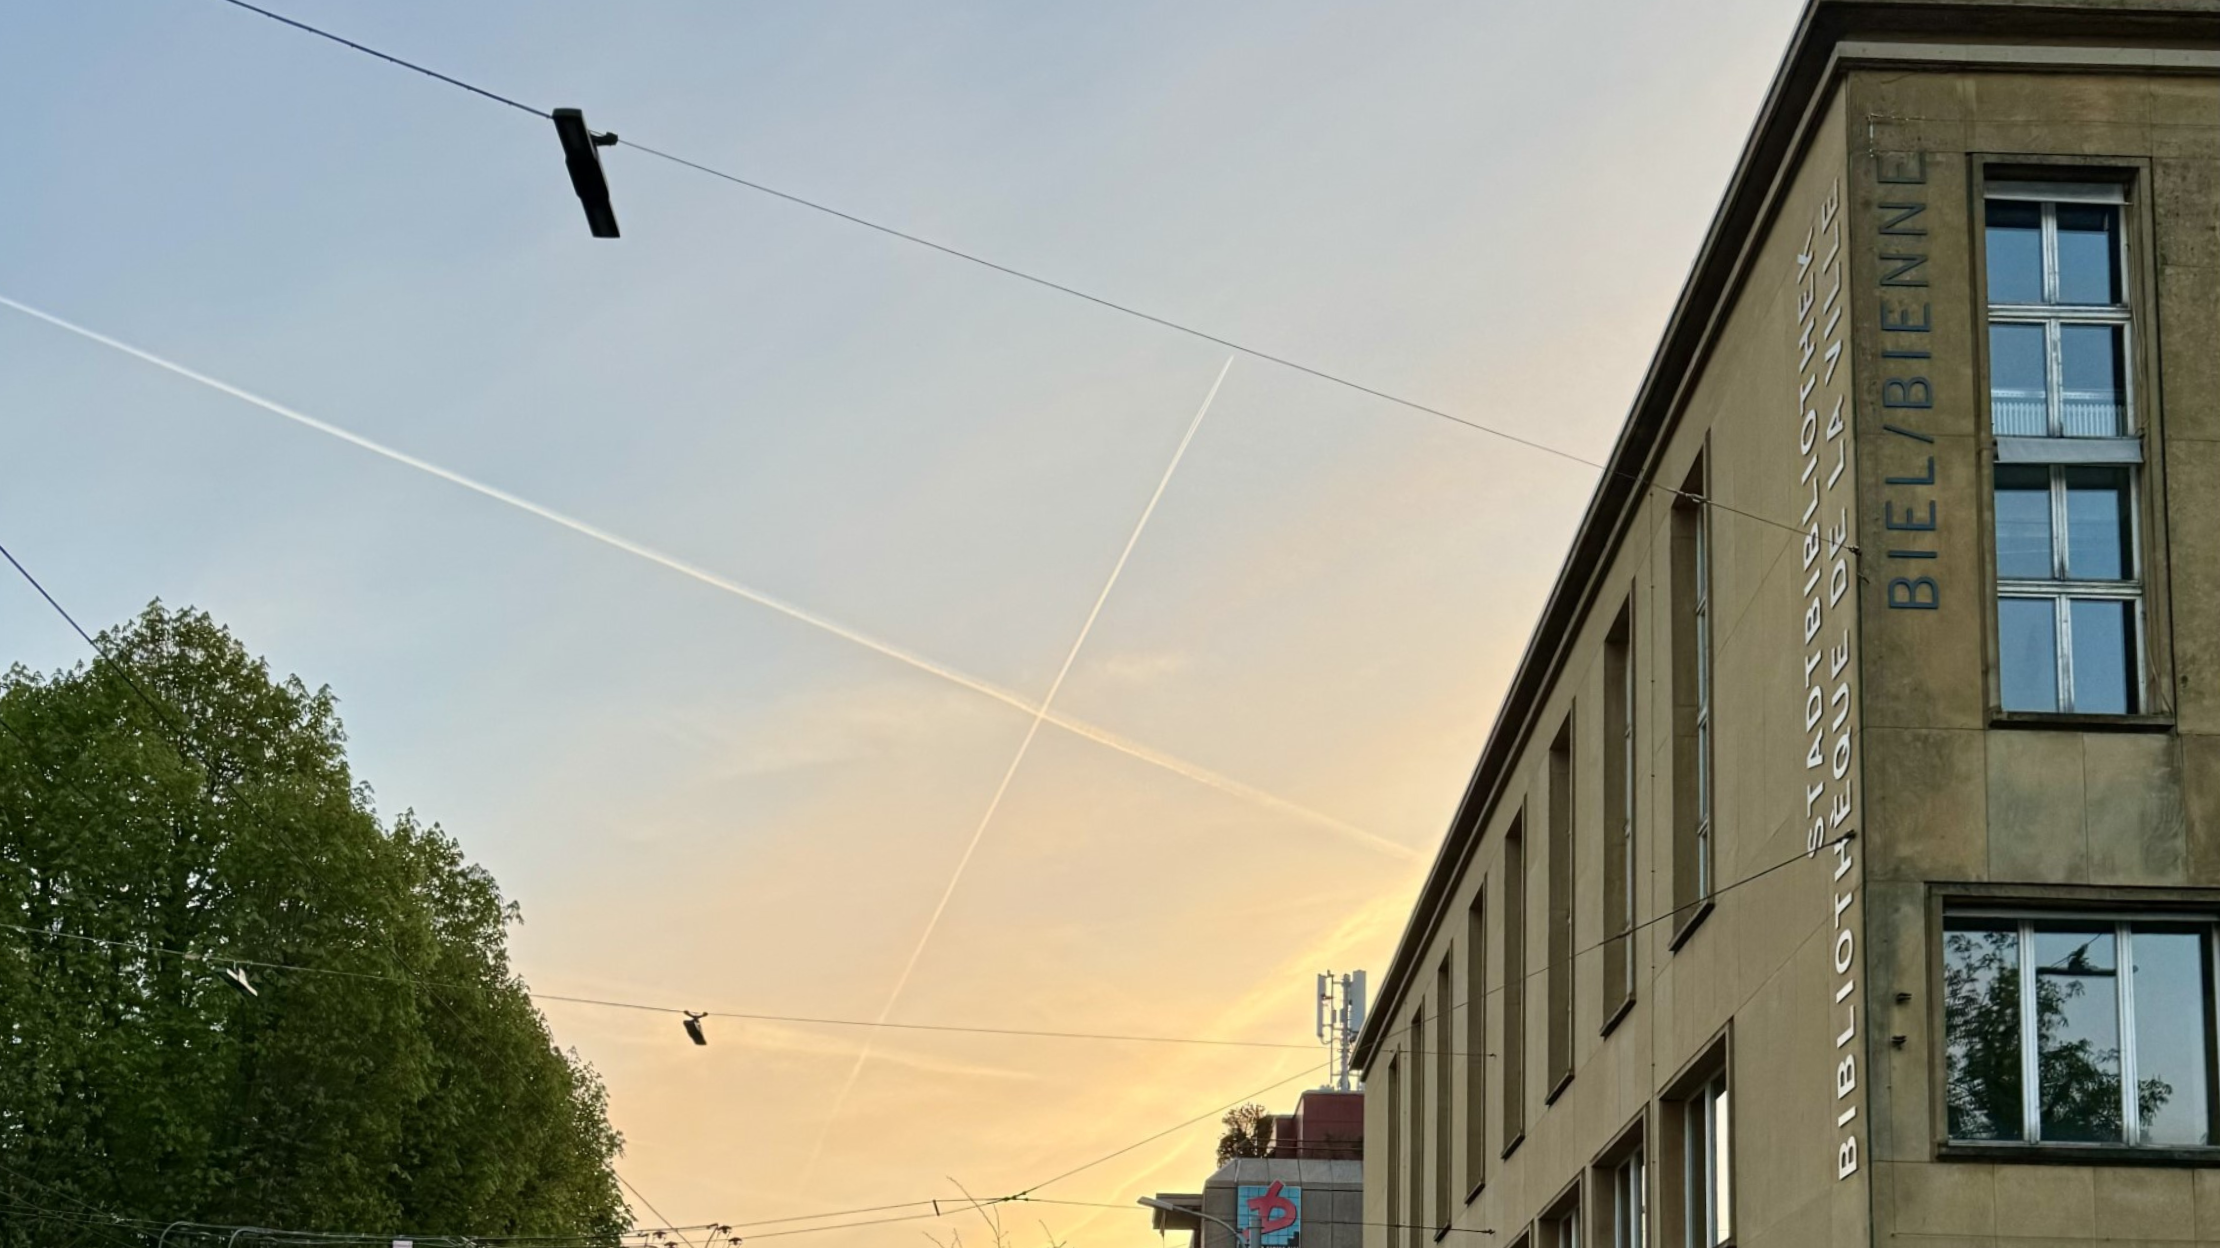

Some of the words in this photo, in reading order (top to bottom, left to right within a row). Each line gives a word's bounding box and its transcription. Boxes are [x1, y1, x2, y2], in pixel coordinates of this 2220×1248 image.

[1821, 177, 1842, 385] VILLE
[1827, 394, 1845, 491] LA
[1877, 149, 1939, 609] BIEL/BIENNE
[1797, 225, 1825, 859] STADTBIBLIOTHEK
[1829, 507, 1848, 609] DE
[1830, 628, 1858, 1181] BIBLIOTHÈQUE
